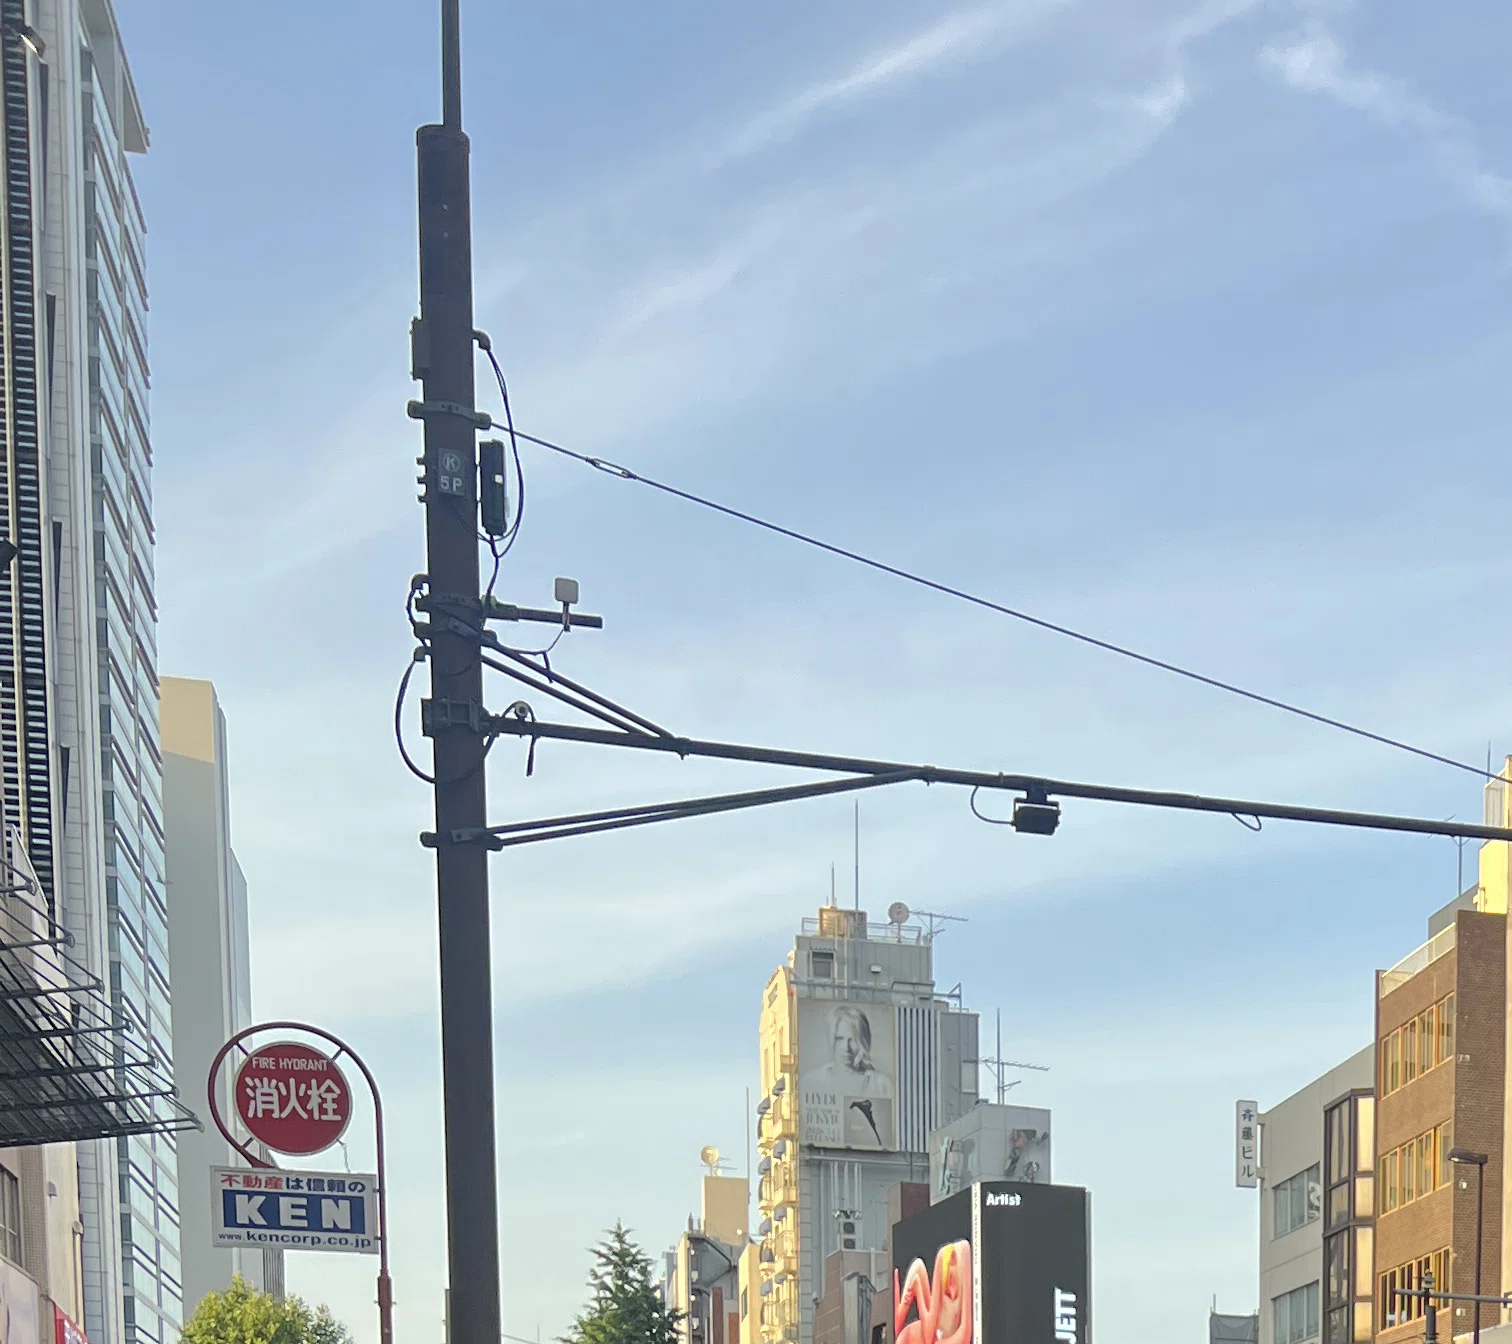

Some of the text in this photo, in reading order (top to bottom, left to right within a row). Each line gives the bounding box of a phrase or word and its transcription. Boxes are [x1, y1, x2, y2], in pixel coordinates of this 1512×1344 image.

[252, 1057, 328, 1071] FIRE HYDRANT
[244, 1076, 342, 1121] 消火栓
[220, 1173, 366, 1194] 不動産は信頼の
[986, 1192, 1022, 1206] Artist
[234, 1194, 351, 1230] KEN
[218, 1230, 371, 1249] www.kencorp.co.jp
